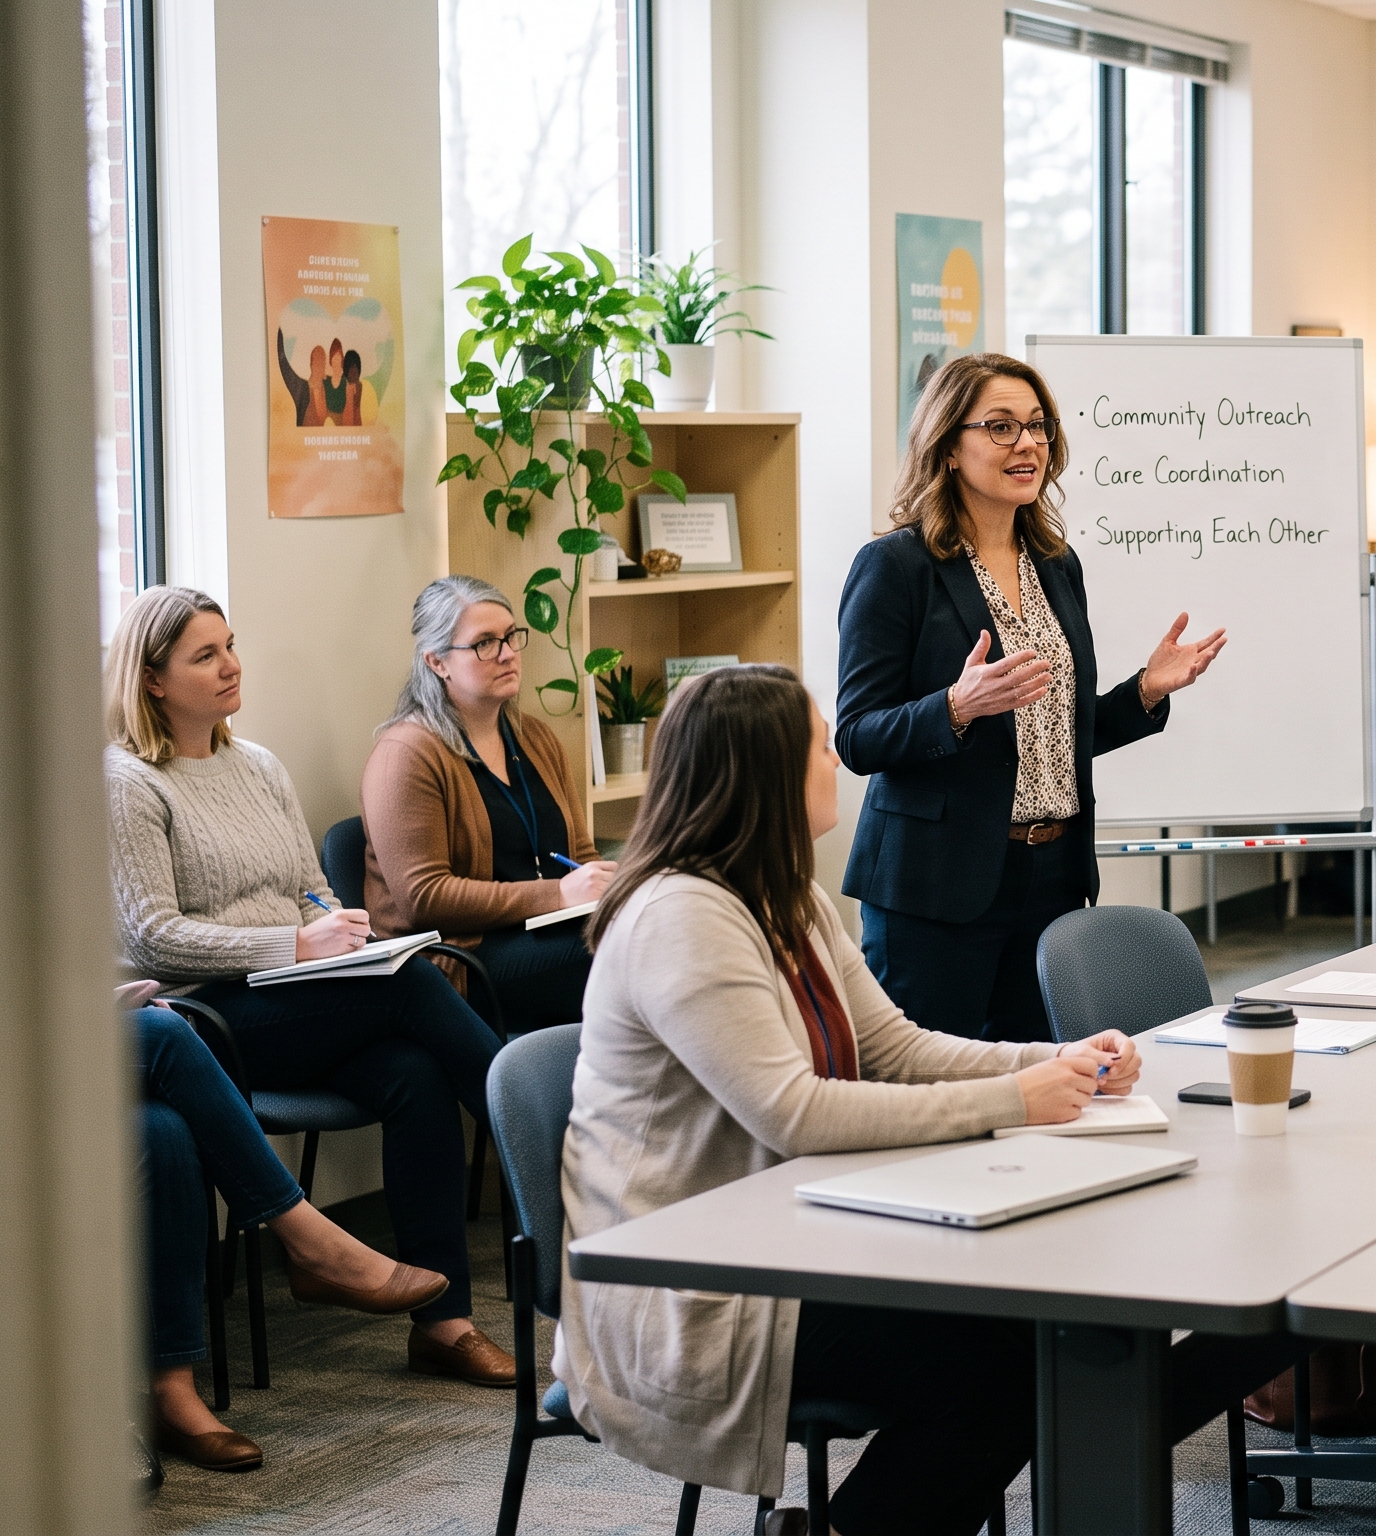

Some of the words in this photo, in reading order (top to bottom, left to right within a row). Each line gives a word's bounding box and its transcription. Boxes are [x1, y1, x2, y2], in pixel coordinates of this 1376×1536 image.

[1093, 394, 1206, 440] Community
[1217, 397, 1311, 427] Outreach
[1094, 455, 1144, 486] Care
[1155, 455, 1285, 484] Coordination
[1096, 516, 1203, 560] Supporting
[1212, 516, 1261, 544] Each
[1268, 517, 1330, 545] Other
